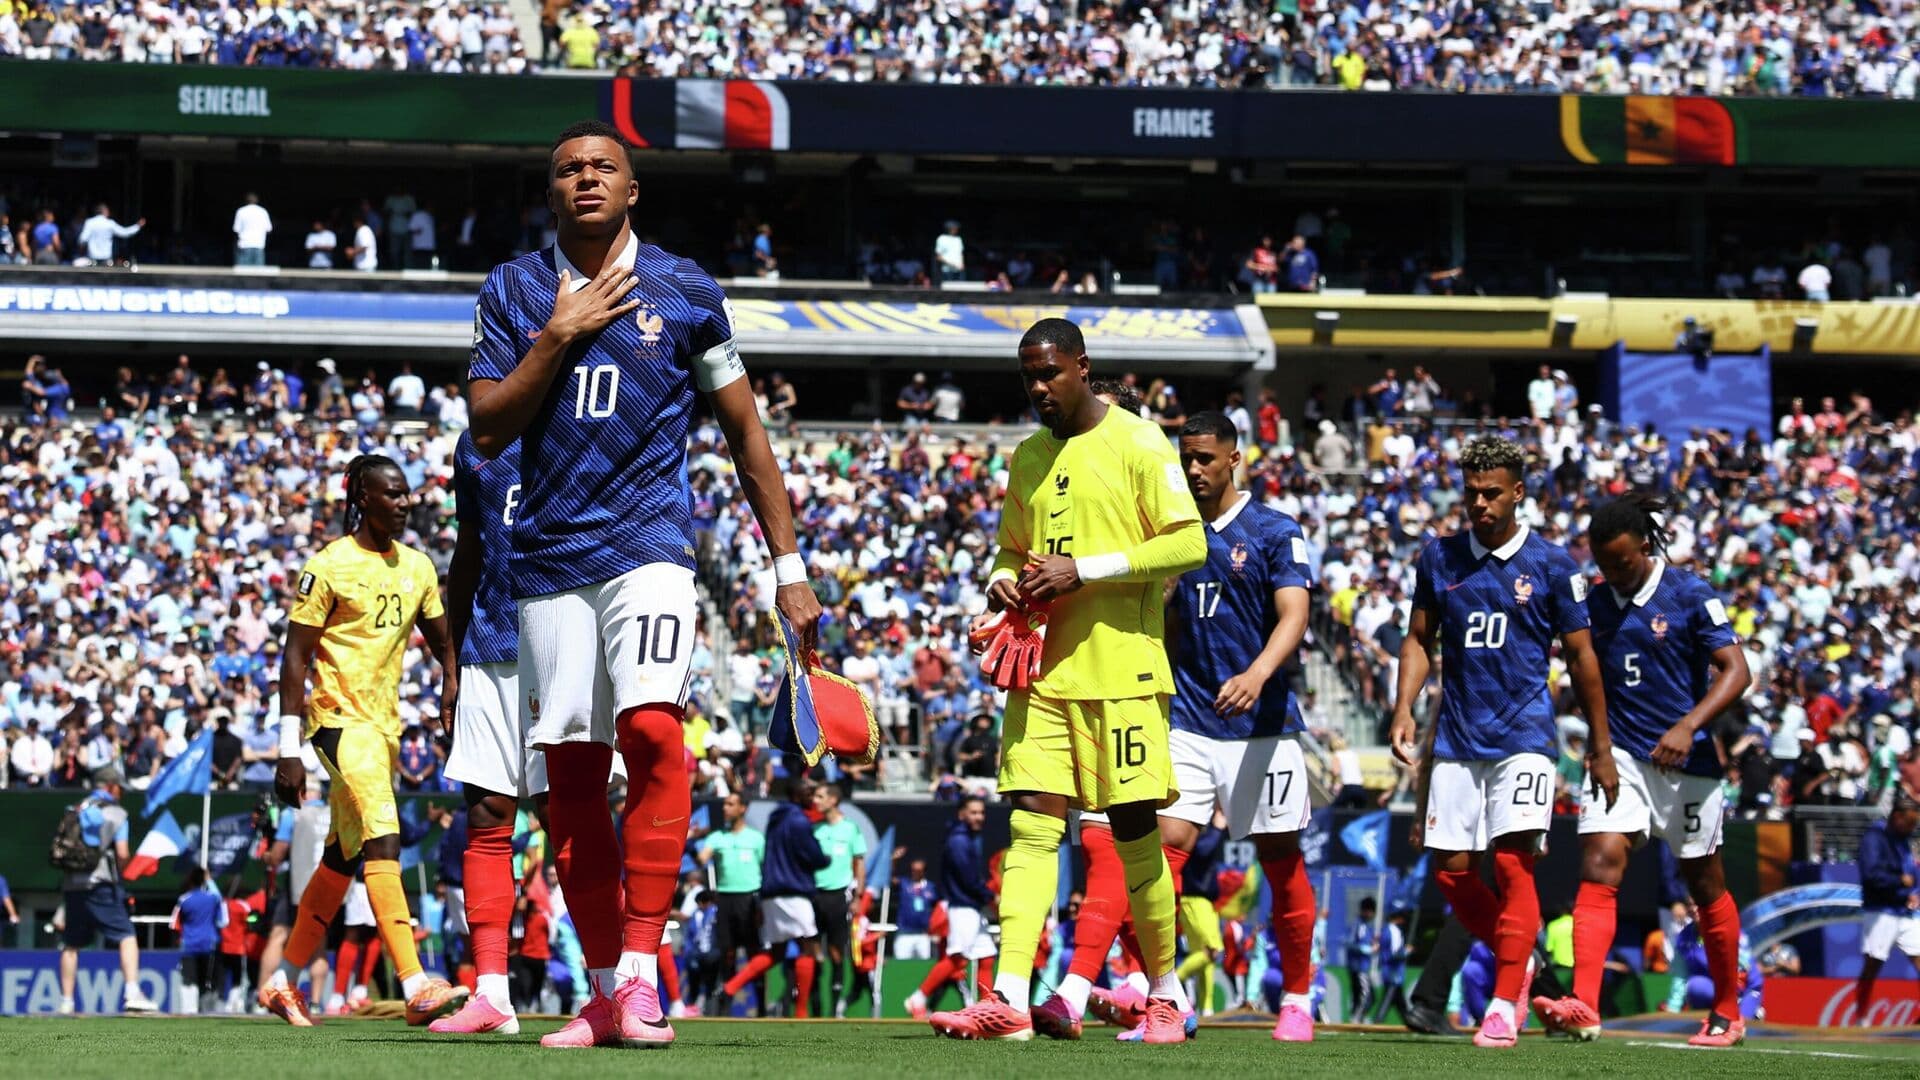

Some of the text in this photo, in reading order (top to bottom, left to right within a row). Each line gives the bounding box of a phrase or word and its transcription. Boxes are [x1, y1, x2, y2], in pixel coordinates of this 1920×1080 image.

[179, 85, 270, 116] SENEGAL
[1133, 107, 1214, 138] FRANCE
[574, 364, 620, 419] 10
[376, 593, 402, 628] 23
[1196, 581, 1222, 618] 17
[637, 614, 680, 666] 10
[1464, 611, 1508, 649] 20
[1624, 652, 1641, 687] 5
[1111, 725, 1146, 768] 16
[1265, 770, 1293, 807] 17
[1512, 772, 1547, 806] 20
[1684, 802, 1701, 833] 5
